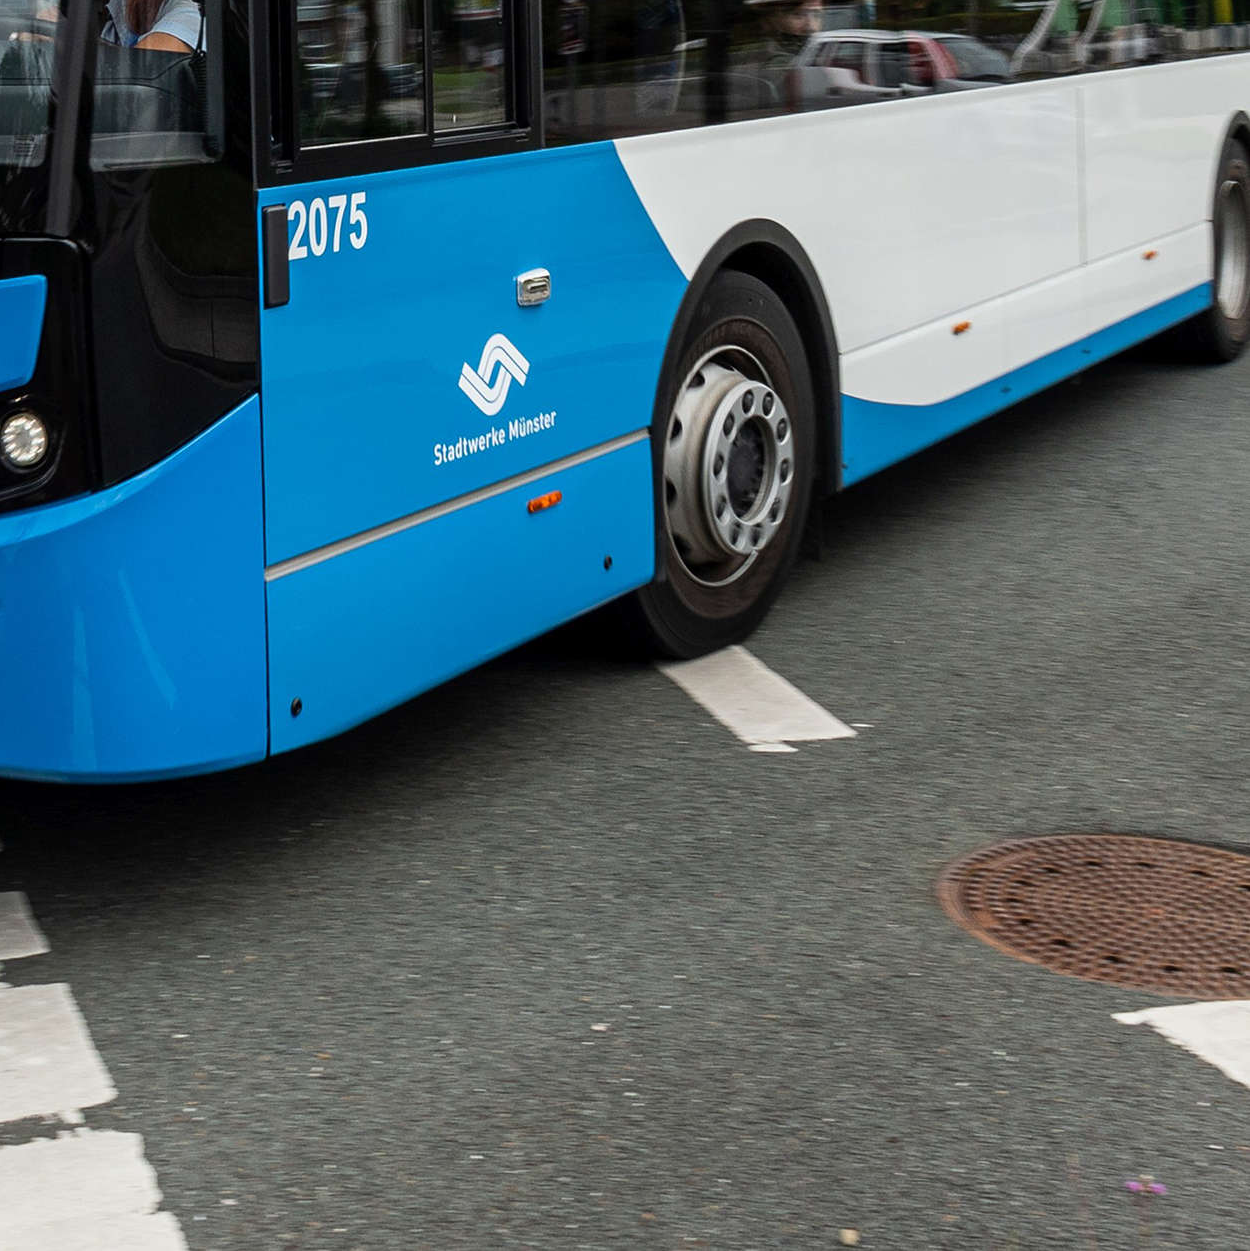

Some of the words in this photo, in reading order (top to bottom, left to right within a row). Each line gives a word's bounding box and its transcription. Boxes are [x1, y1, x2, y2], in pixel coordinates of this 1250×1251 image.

[287, 191, 368, 261] 2075
[433, 426, 506, 466] Stadtwerke
[508, 410, 557, 440] Münster
